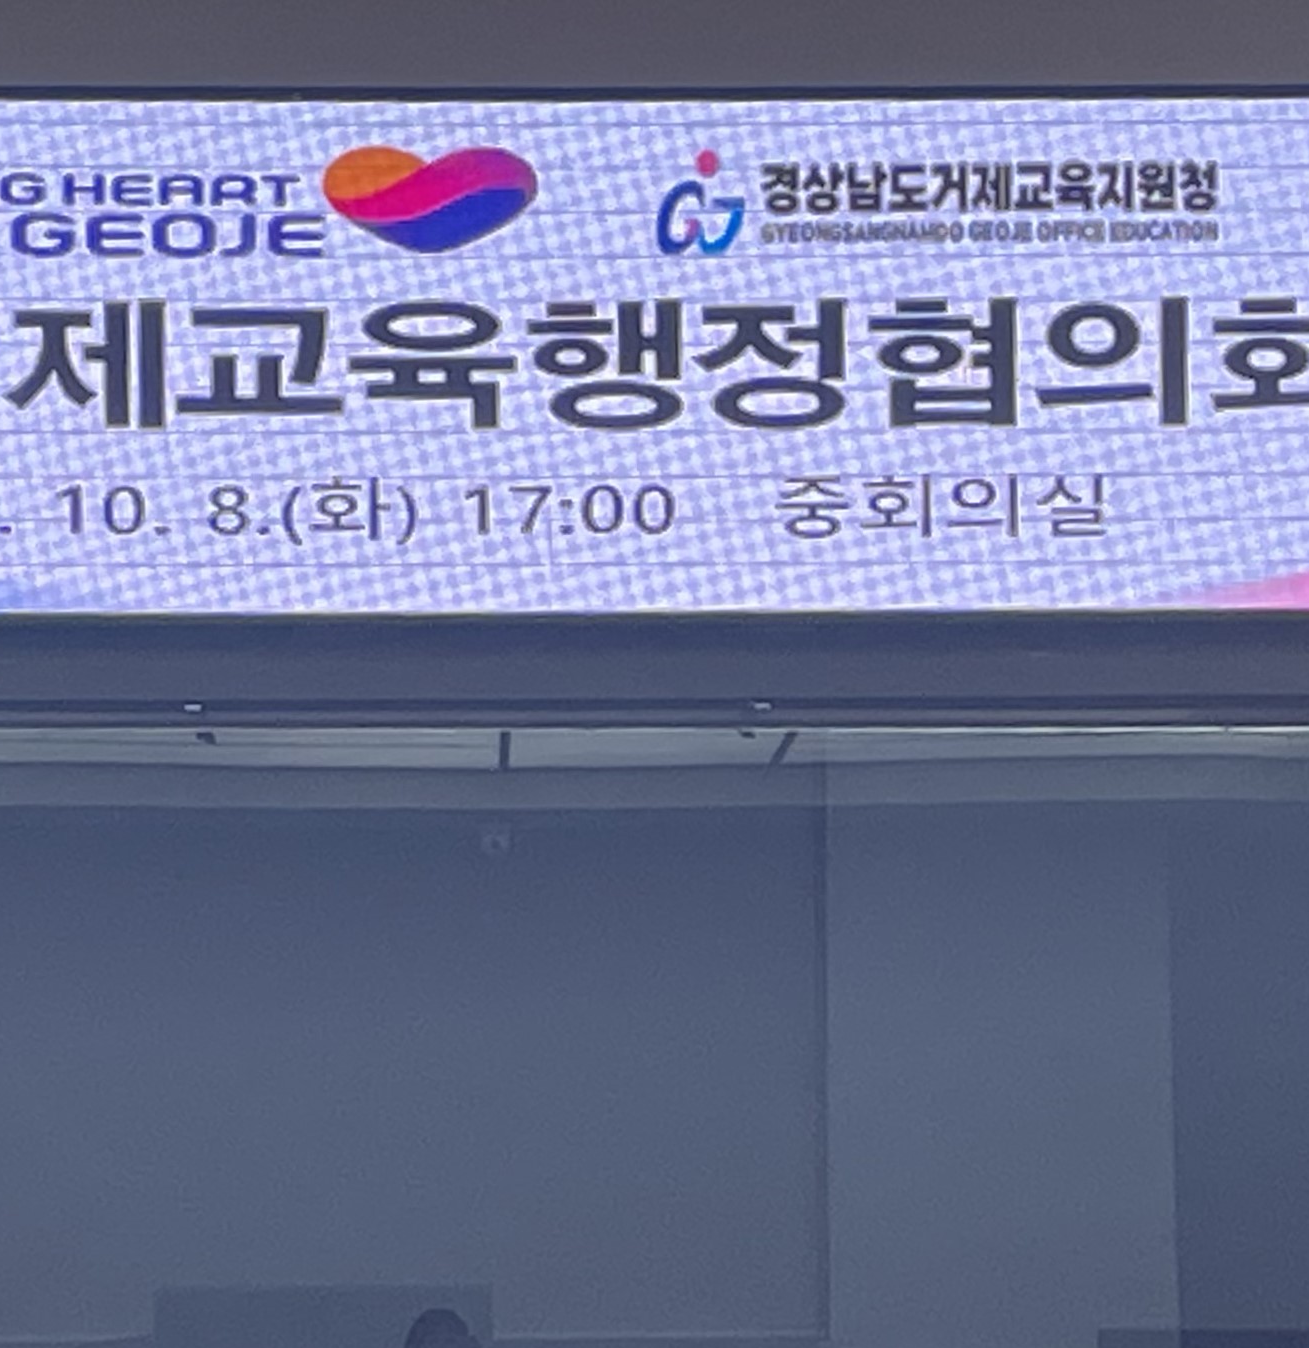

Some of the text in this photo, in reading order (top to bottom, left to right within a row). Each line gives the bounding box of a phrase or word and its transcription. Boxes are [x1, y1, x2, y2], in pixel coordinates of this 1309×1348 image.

[61, 172, 301, 208] HEART
[759, 160, 1221, 214] 경상남도거제교육지원청
[9, 211, 328, 259] GEOJE
[967, 220, 1034, 244] GEOJE
[1036, 220, 1105, 244] OFFICE
[1108, 219, 1220, 244] EDUCATION
[55, 483, 172, 536] 10.
[205, 475, 420, 547] 8.(화)
[463, 483, 677, 536] 17:00
[773, 472, 1109, 540] 중회의실
